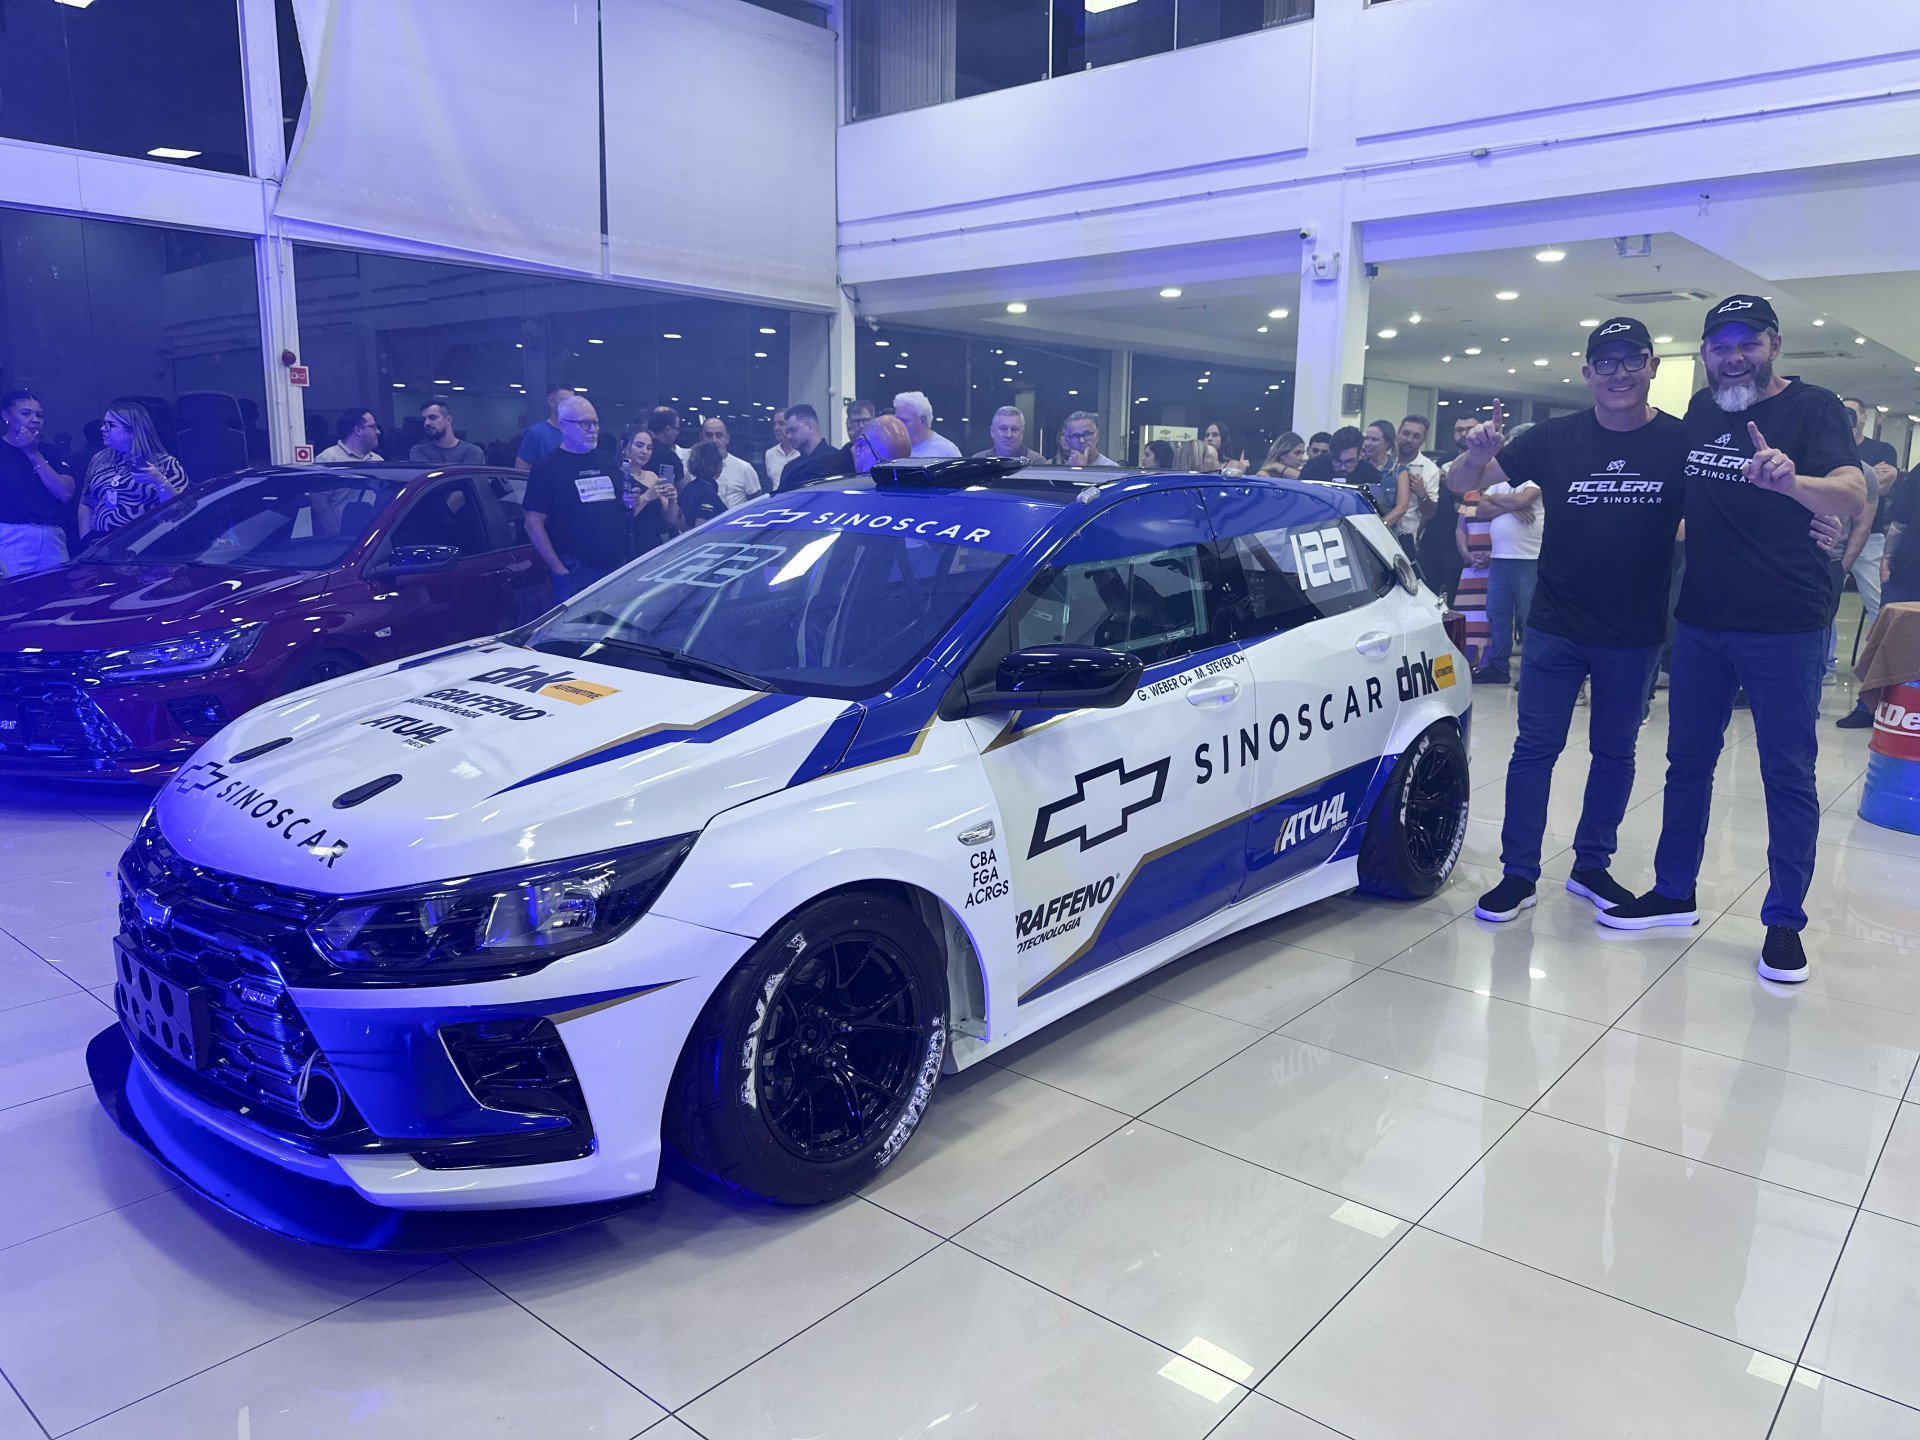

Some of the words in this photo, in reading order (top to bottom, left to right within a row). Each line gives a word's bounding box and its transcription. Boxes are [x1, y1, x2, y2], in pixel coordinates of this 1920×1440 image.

[1568, 481, 1664, 493] ACELERA
[1701, 469, 1751, 484] SINOSCA
[812, 512, 991, 542] SINOSCAR
[1290, 527, 1352, 590] 122
[468, 664, 577, 694] dnk
[1137, 689, 1150, 701] G.
[1148, 677, 1180, 698] WEBER
[1194, 667, 1208, 680] M.
[1205, 657, 1234, 675] STEYER
[1396, 650, 1439, 702] dnk
[423, 688, 547, 721] GRAFFENO
[367, 714, 453, 744] ATUAL
[1194, 676, 1383, 784] SINOSCAR
[216, 781, 349, 869] SINOSCAR
[1280, 791, 1349, 852] ATUAL
[970, 848, 997, 869] CBA
[973, 866, 999, 888] FGA
[965, 880, 1009, 909] ACRGS
[1015, 875, 1115, 940] RAFFENO
